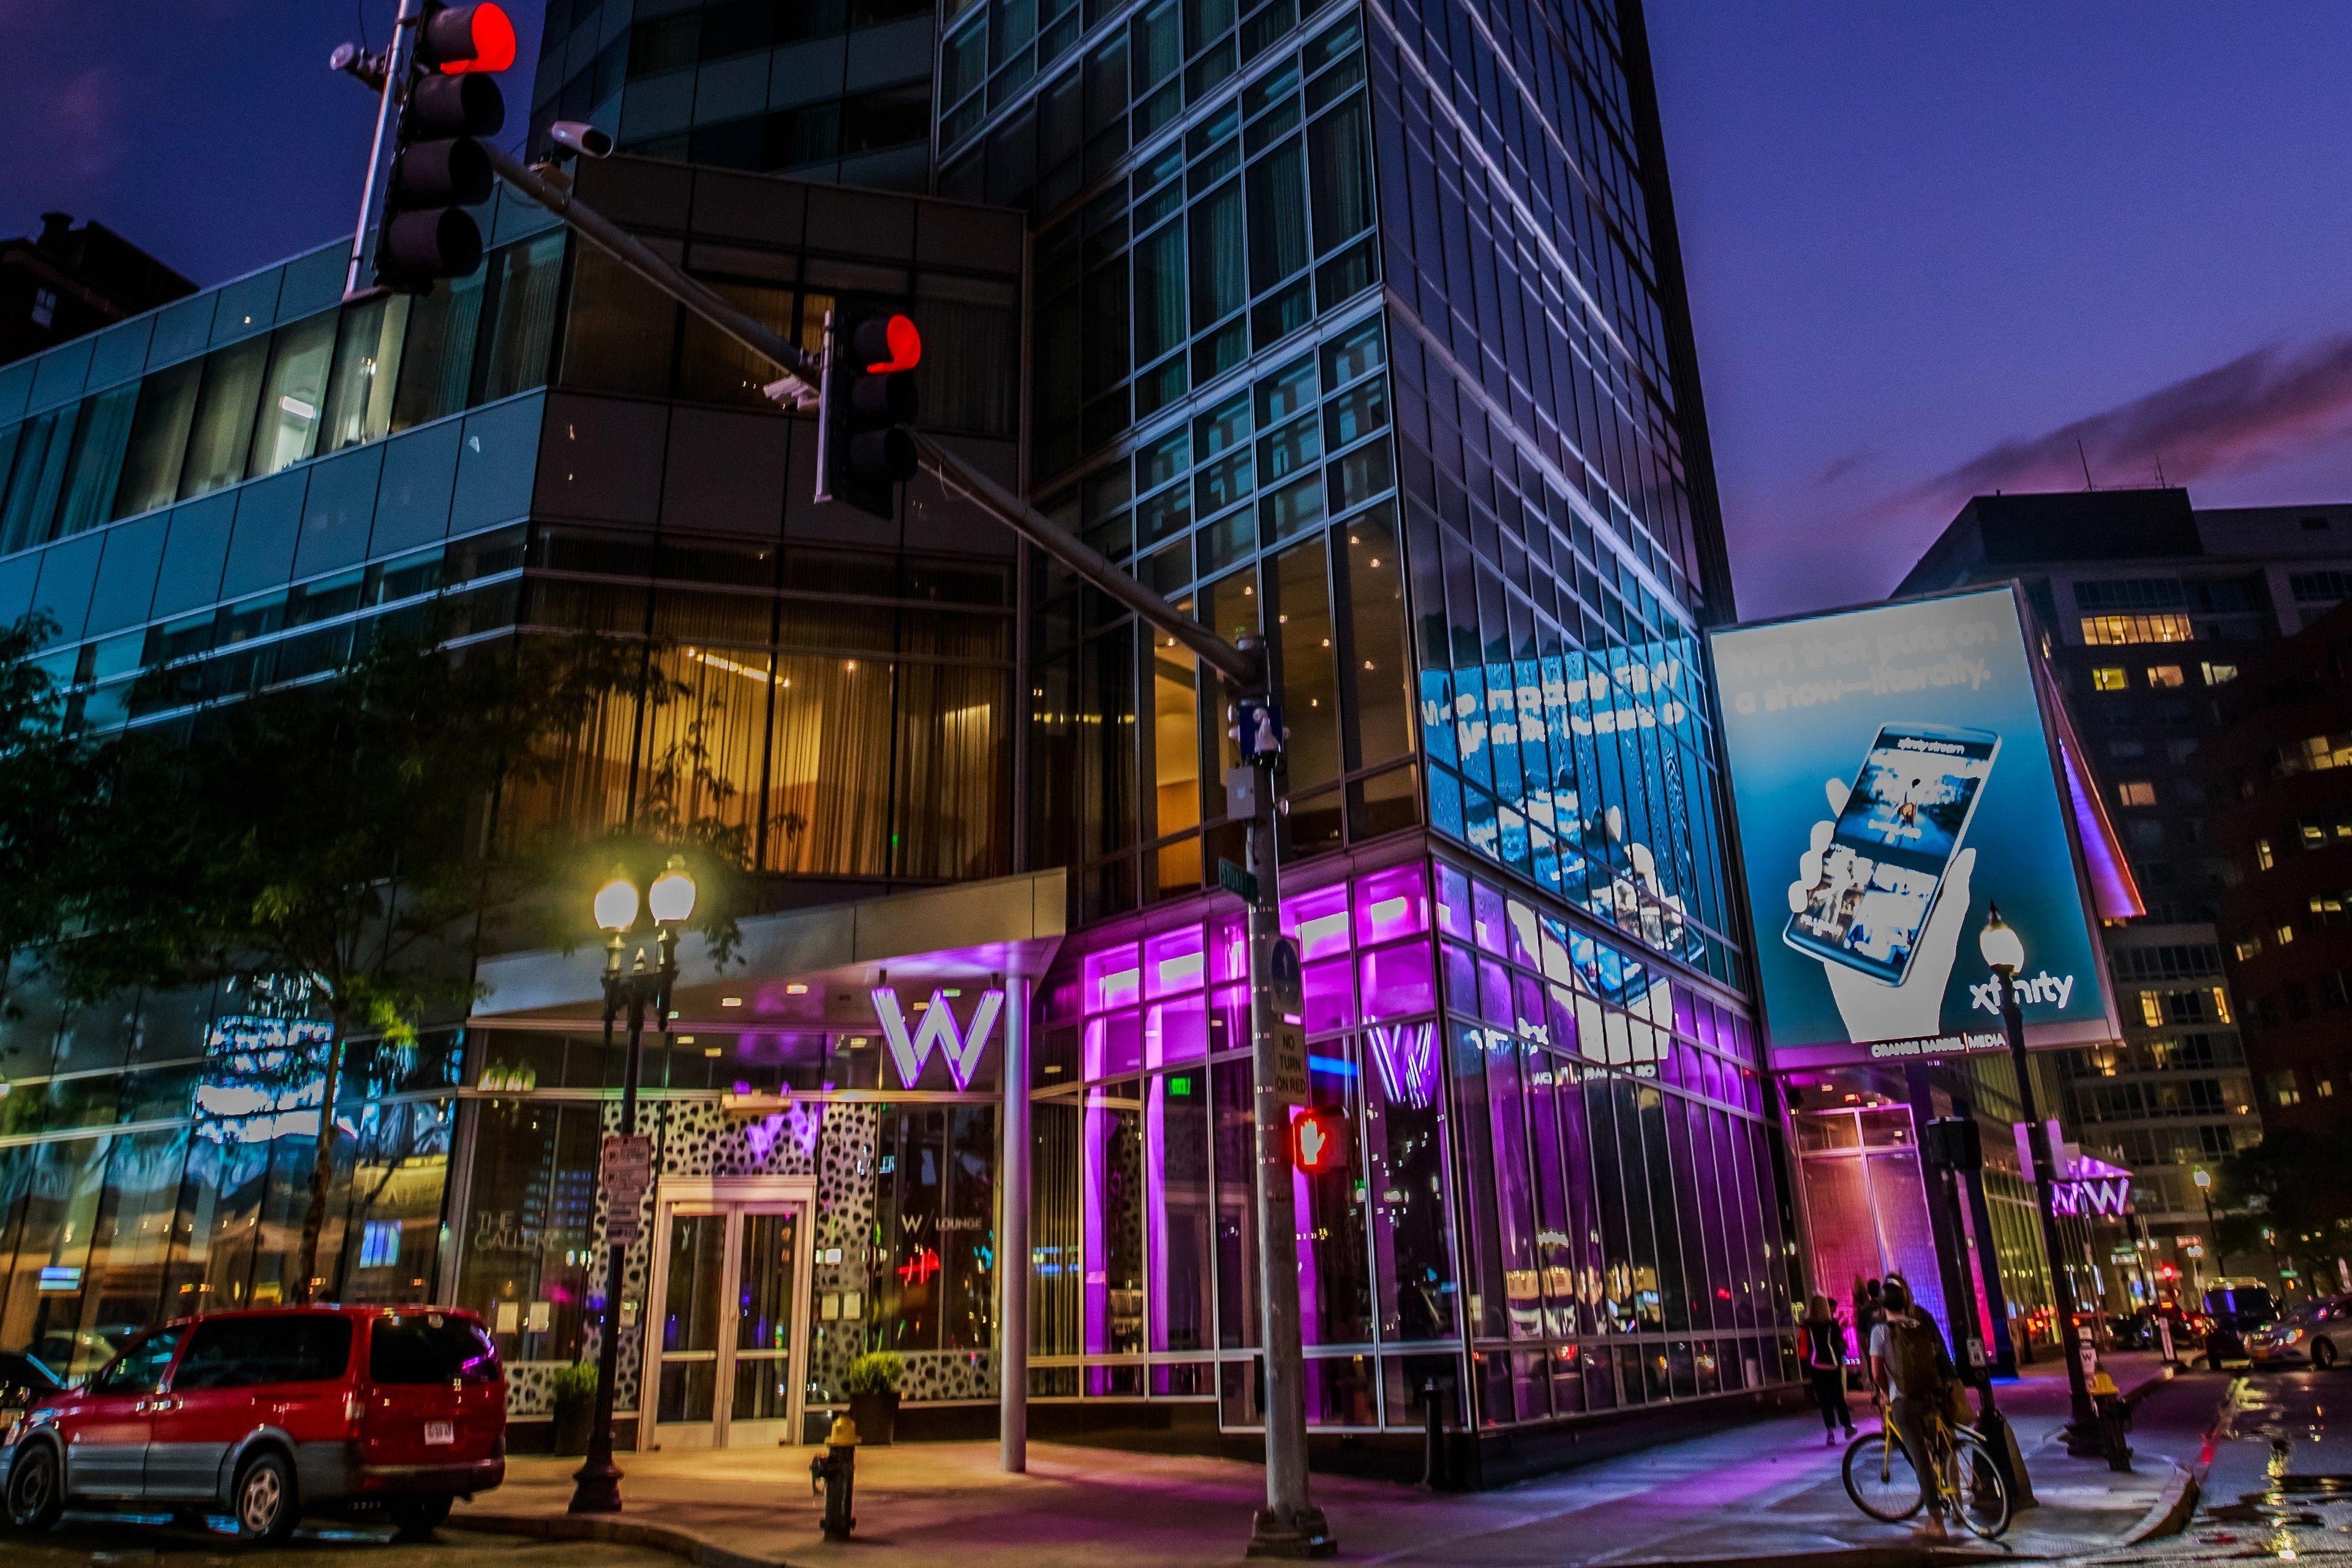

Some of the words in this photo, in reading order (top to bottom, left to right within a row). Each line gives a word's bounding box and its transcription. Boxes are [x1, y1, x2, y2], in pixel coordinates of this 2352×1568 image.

[1954, 620, 1998, 646] on
[1735, 692, 1756, 715] a
[1969, 971, 2073, 1015] xfnity
[872, 987, 1005, 1091] W
[1283, 1035, 1295, 1051] NO
[1968, 1033, 2006, 1049] MEDIA
[1280, 1054, 1301, 1072] TURN
[1276, 1075, 1289, 1091] ON
[1289, 1077, 1306, 1094] RED
[2082, 1178, 2129, 1216] W
[902, 1213, 923, 1235] W
[935, 1216, 982, 1232] LOUNGE
